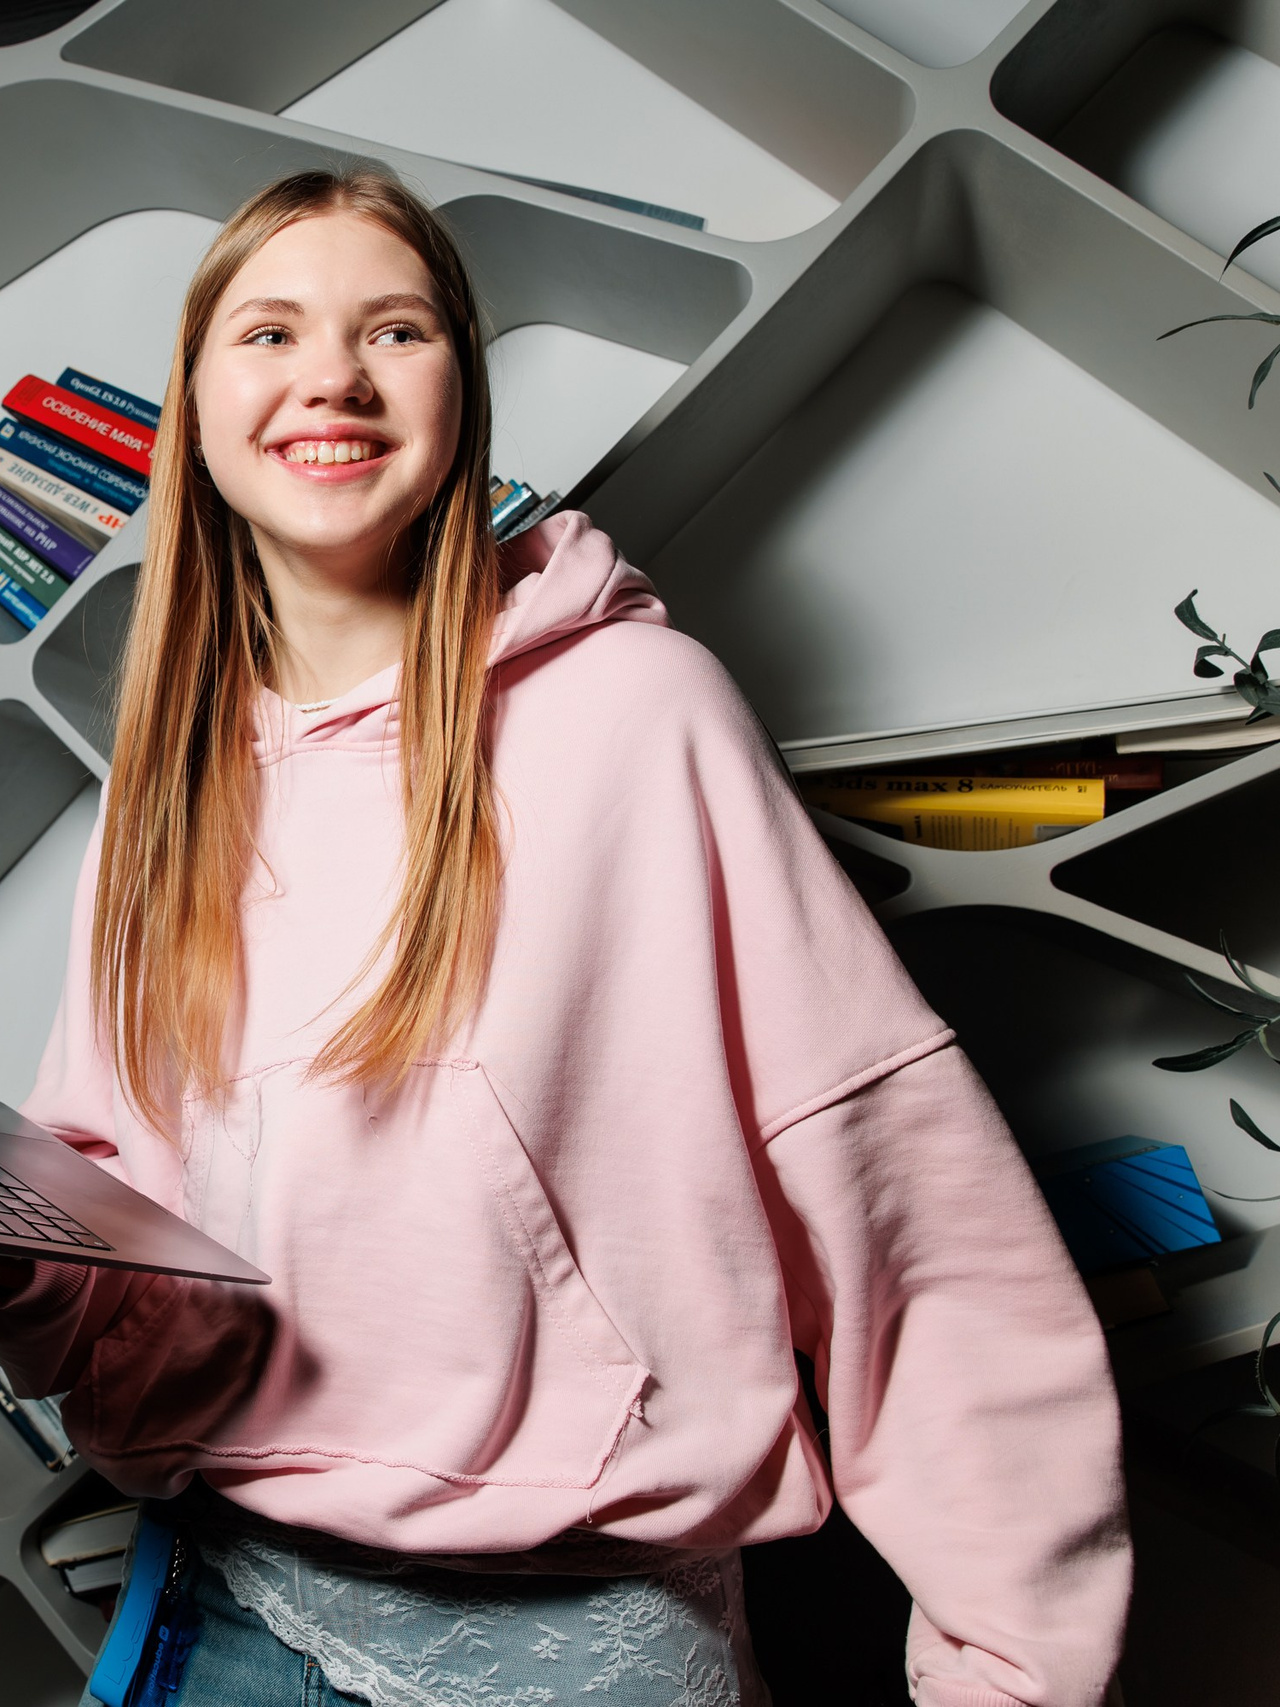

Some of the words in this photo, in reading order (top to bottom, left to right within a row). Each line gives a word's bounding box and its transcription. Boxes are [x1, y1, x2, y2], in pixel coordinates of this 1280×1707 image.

[68, 376, 101, 399] OpenGL
[40, 393, 110, 436] ОСВОЕНИЕ
[53, 445, 99, 477] ЭКОНОМИКА
[32, 531, 58, 553] PHP
[11, 546, 45, 575] ASP.NET
[38, 569, 56, 585] 2.0
[886, 779, 947, 792] max
[957, 778, 974, 792] 8
[980, 782, 1068, 792] САМОУЧИТЕЛЬ
